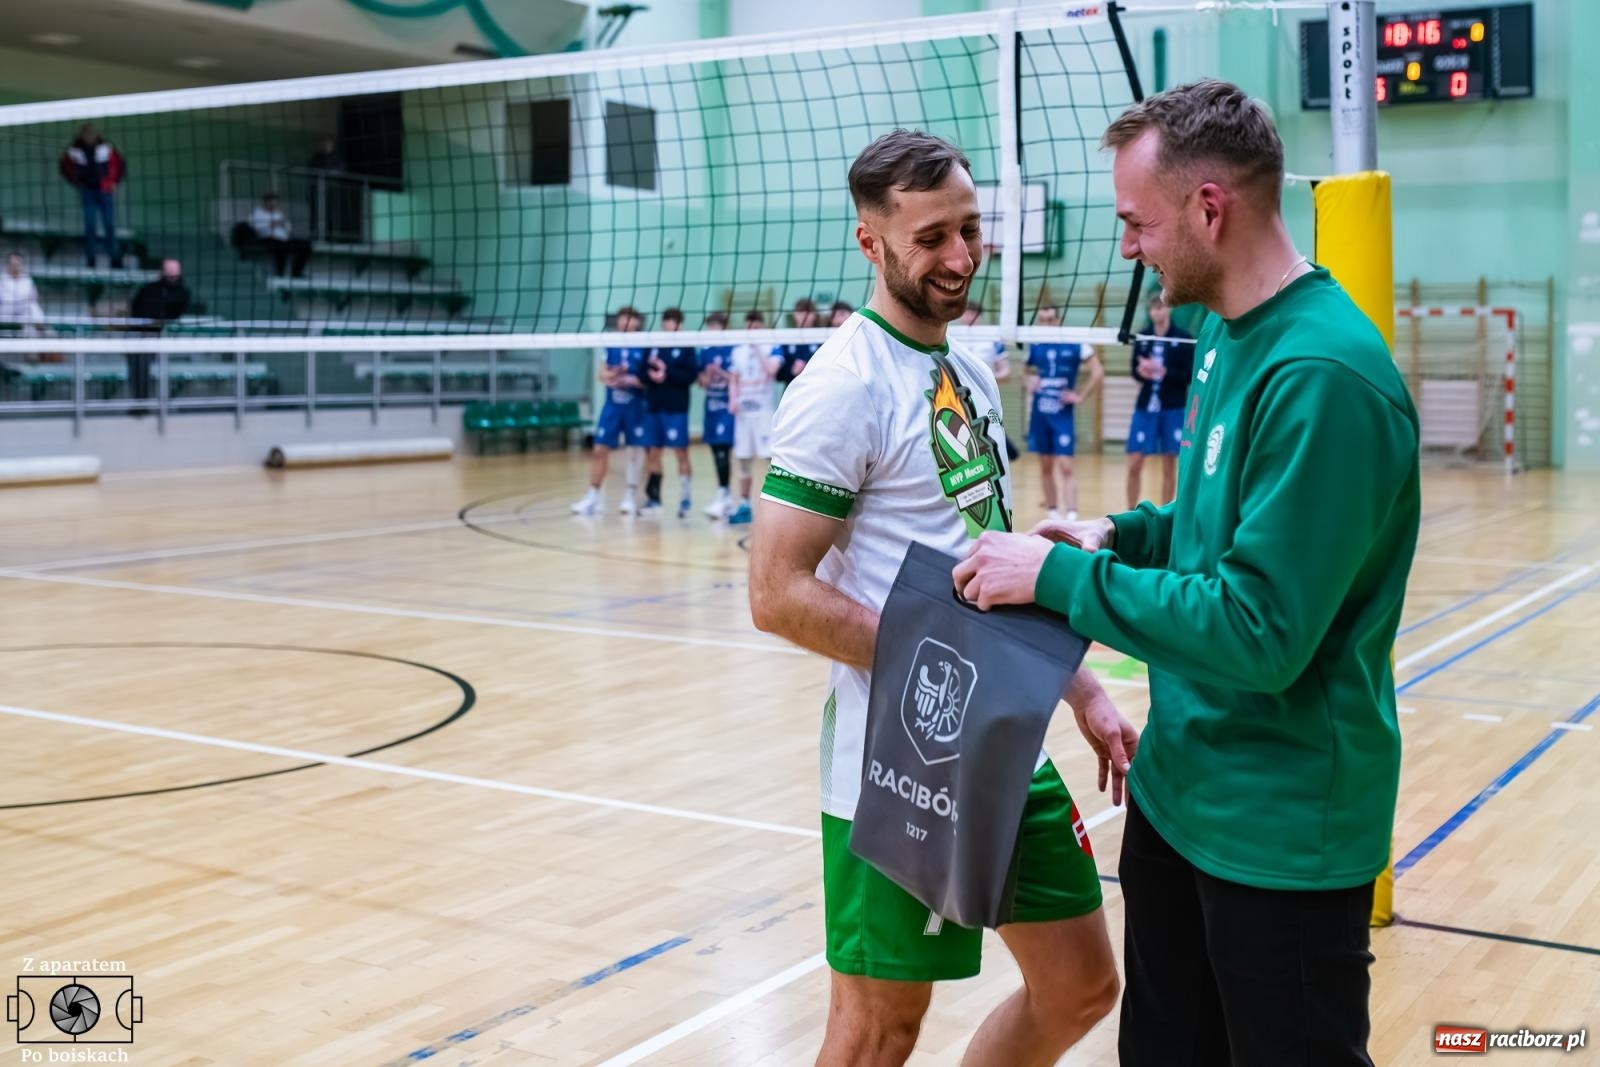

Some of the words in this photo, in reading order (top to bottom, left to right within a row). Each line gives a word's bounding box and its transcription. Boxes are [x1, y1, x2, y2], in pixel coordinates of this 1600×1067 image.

[1342, 27, 1352, 99] sport
[1450, 72, 1468, 97] 0
[950, 471, 963, 487] MVP
[905, 822, 928, 842] 1217
